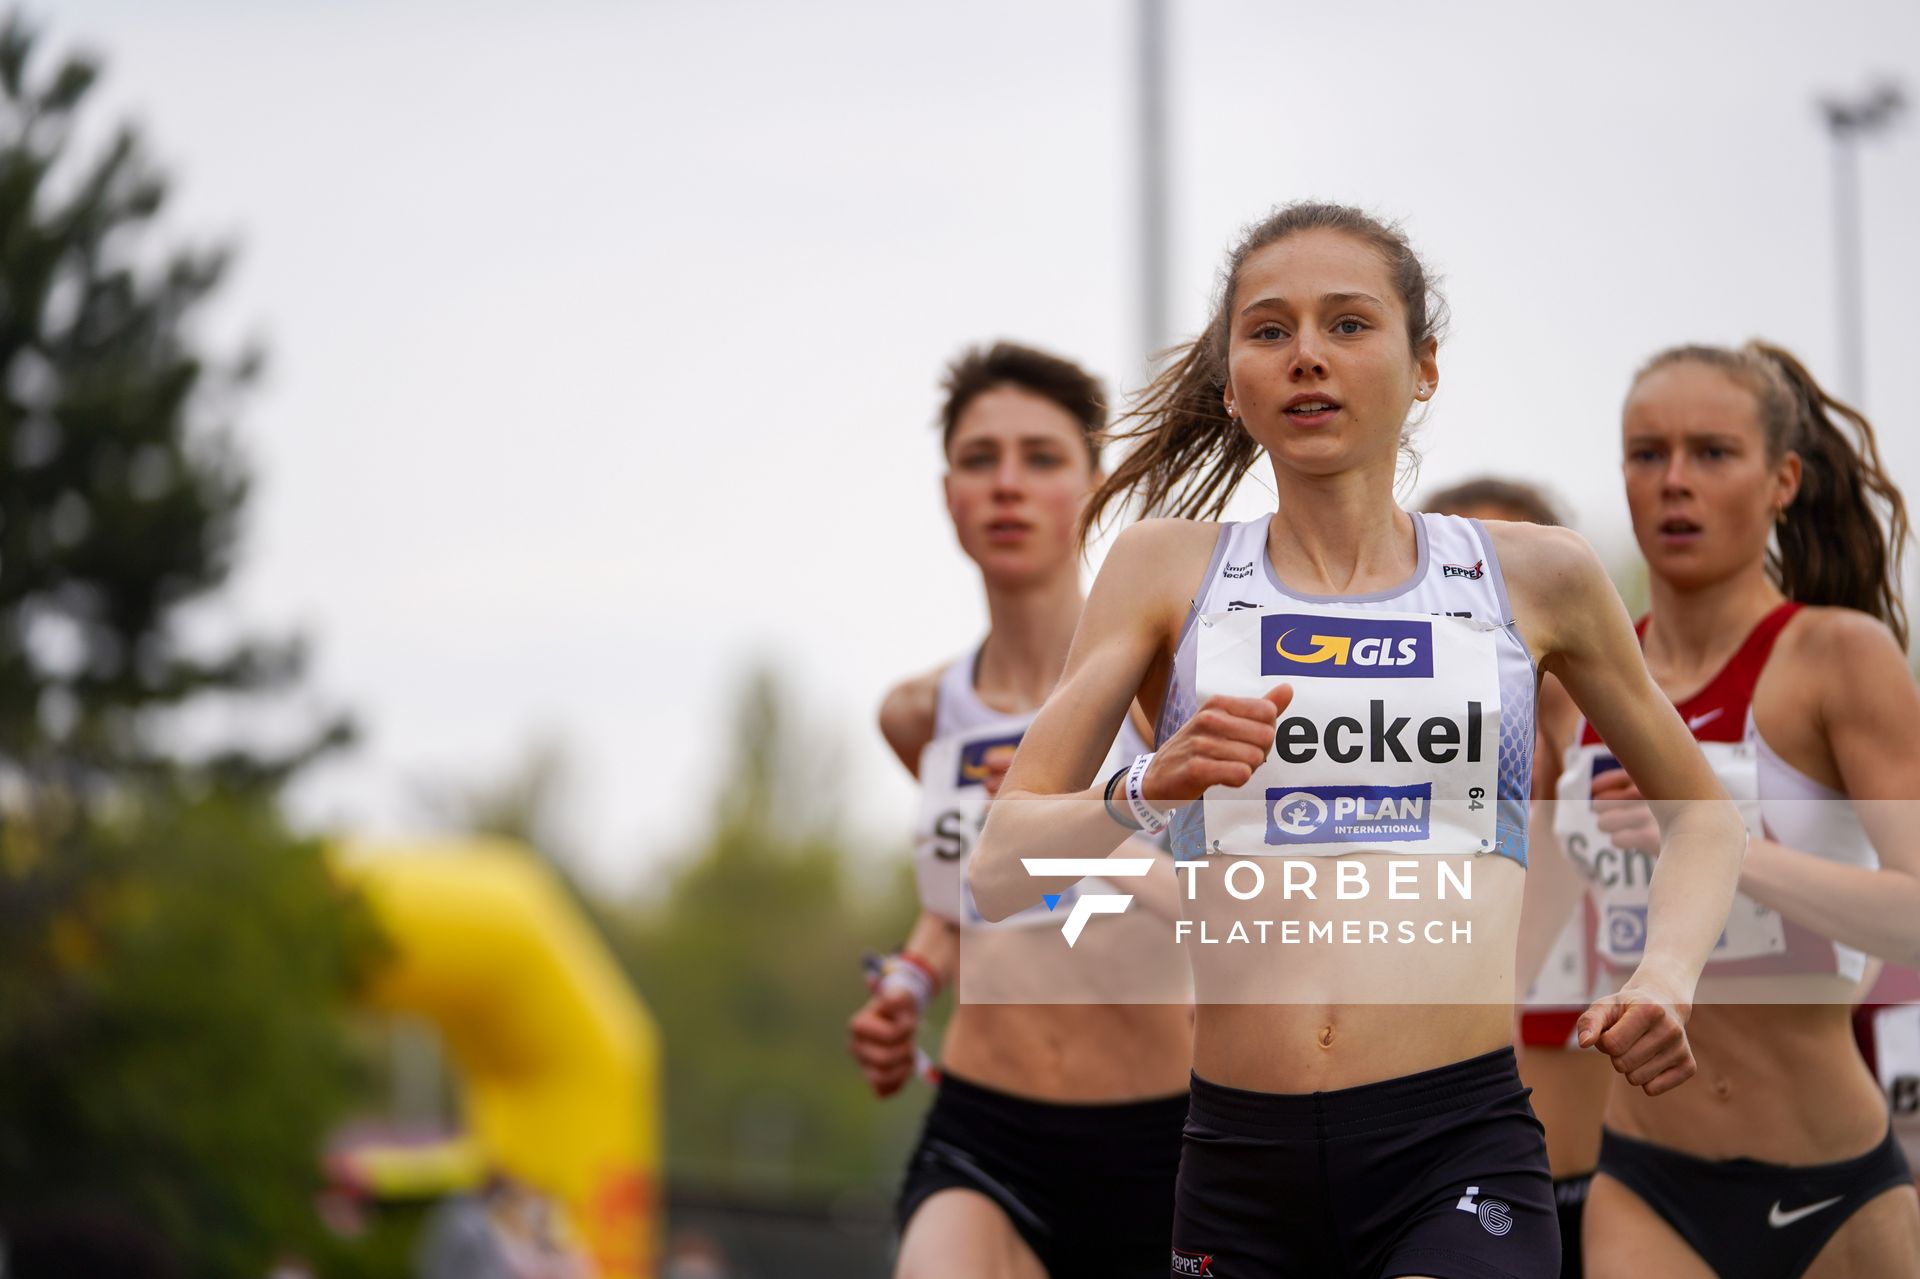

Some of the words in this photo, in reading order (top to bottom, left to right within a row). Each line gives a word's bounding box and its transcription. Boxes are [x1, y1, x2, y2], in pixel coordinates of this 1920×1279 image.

[1352, 637, 1417, 667] GLS
[1264, 699, 1482, 764] eckel
[1129, 755, 1162, 829] ETIK-MEISTE
[1468, 787, 1485, 811] 64
[1334, 796, 1424, 822] PLAN
[1335, 824, 1422, 834] INTERNATIONAL
[1567, 832, 1654, 887] Sch
